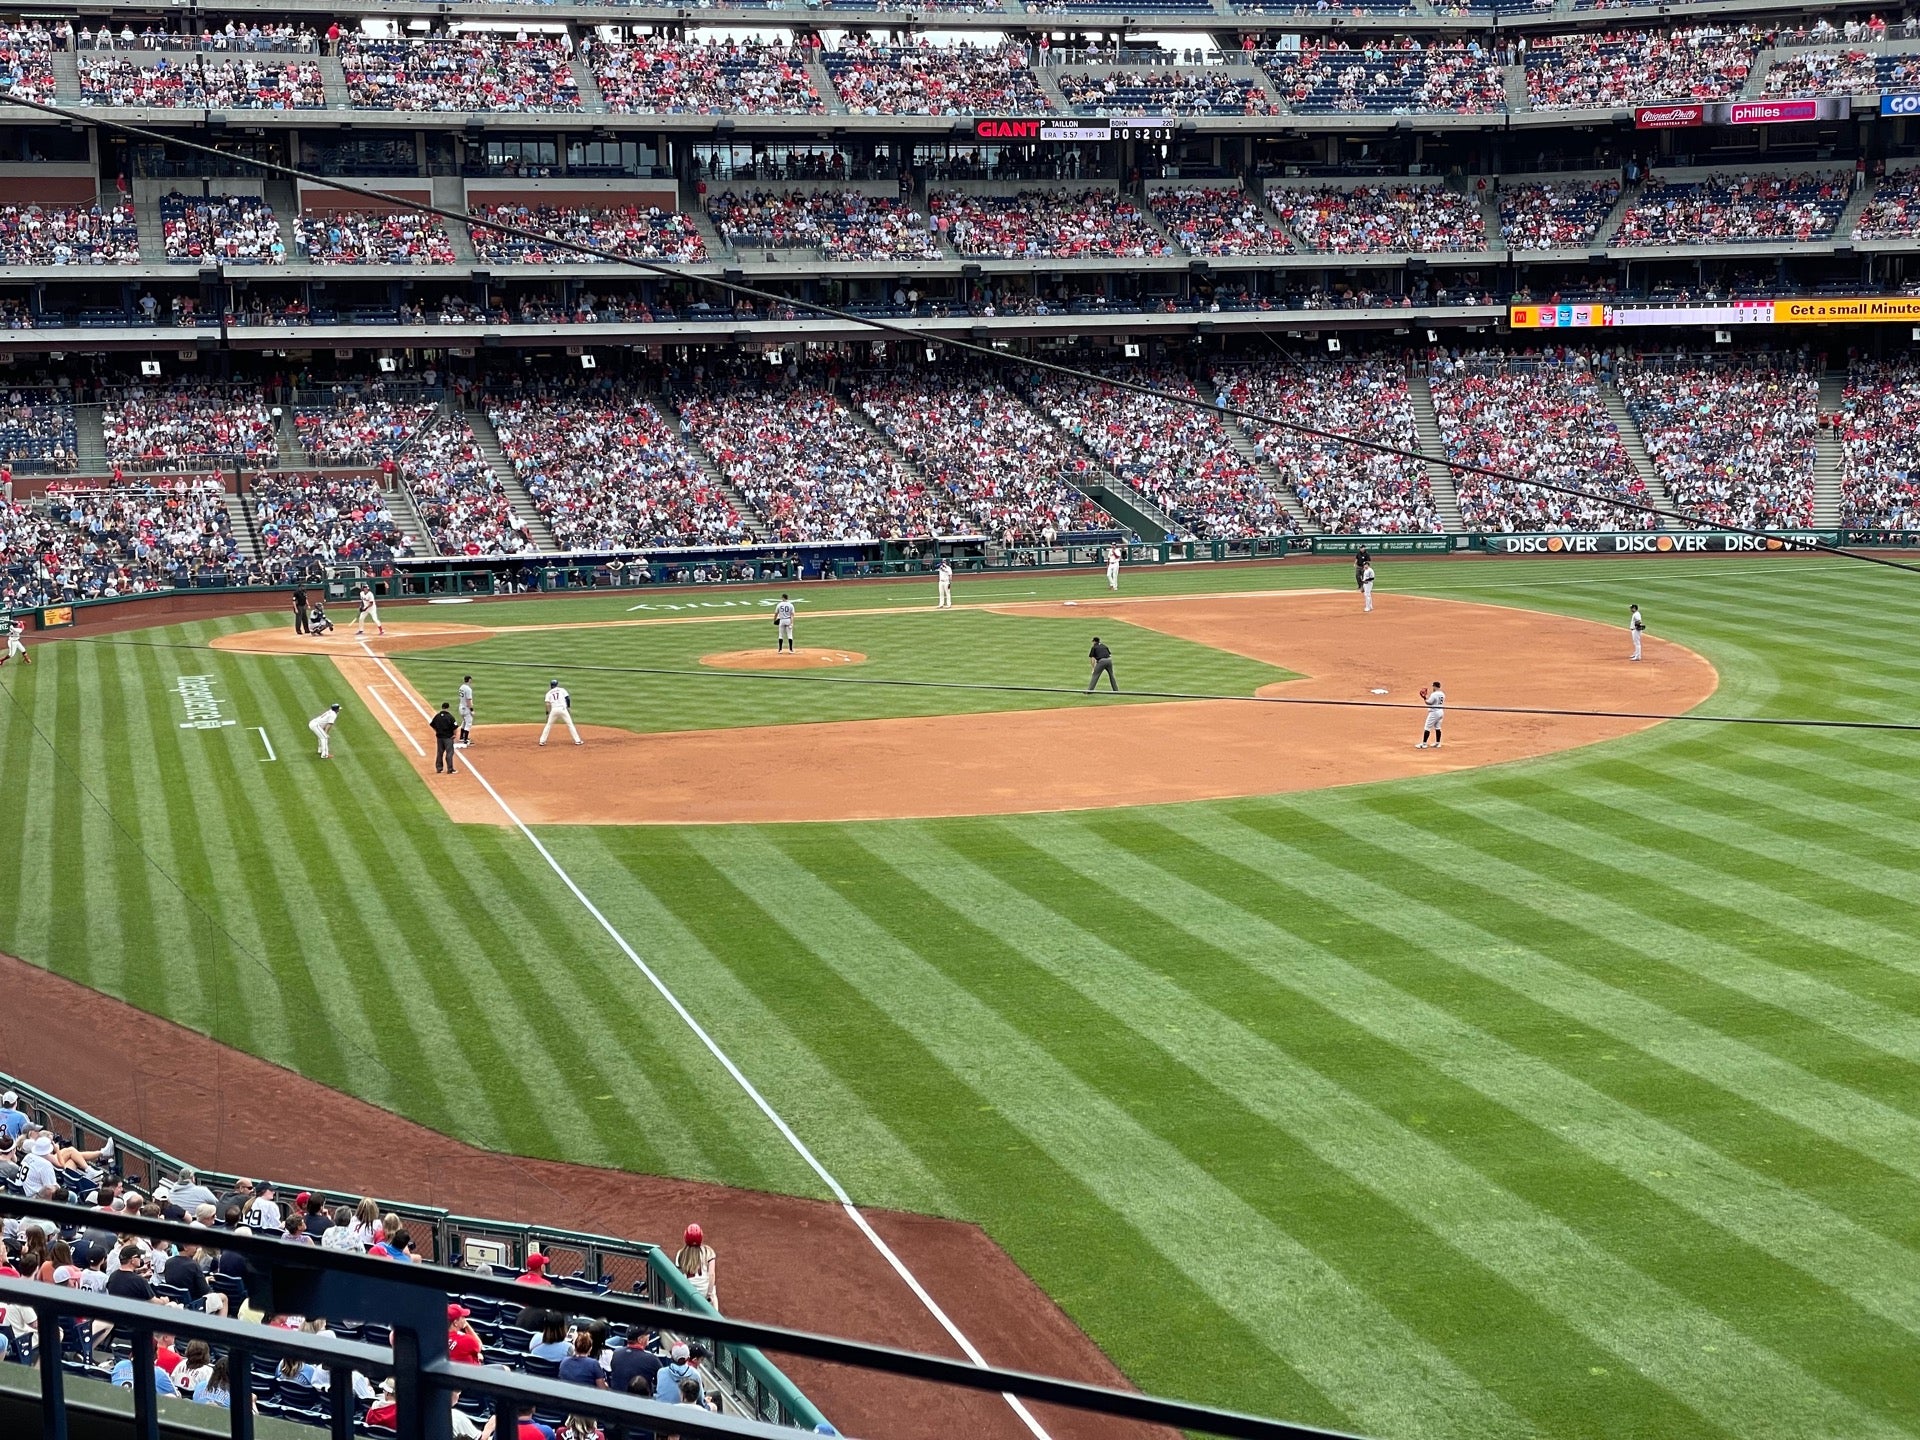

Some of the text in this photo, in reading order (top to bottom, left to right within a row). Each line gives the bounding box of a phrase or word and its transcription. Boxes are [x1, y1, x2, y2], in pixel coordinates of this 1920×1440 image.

[1890, 96, 1920, 113] GO
[1671, 109, 1698, 122] Philly
[1735, 106, 1813, 121] phillies.com
[977, 121, 1039, 138] GIANT
[1051, 120, 1079, 128] TAILLON
[1114, 130, 1120, 139] B
[1122, 129, 1129, 139] 0
[1135, 130, 1141, 139] S
[1143, 129, 1150, 139] 2
[1165, 129, 1171, 139] 1
[1790, 305, 1815, 315] Get
[1829, 304, 1867, 314] small
[1871, 303, 1920, 314] Minute
[1507, 535, 1597, 552] DISCOVER
[1616, 535, 1707, 552] DISCOVER
[552, 692, 559, 700] 17
[245, 1208, 262, 1226] 99
